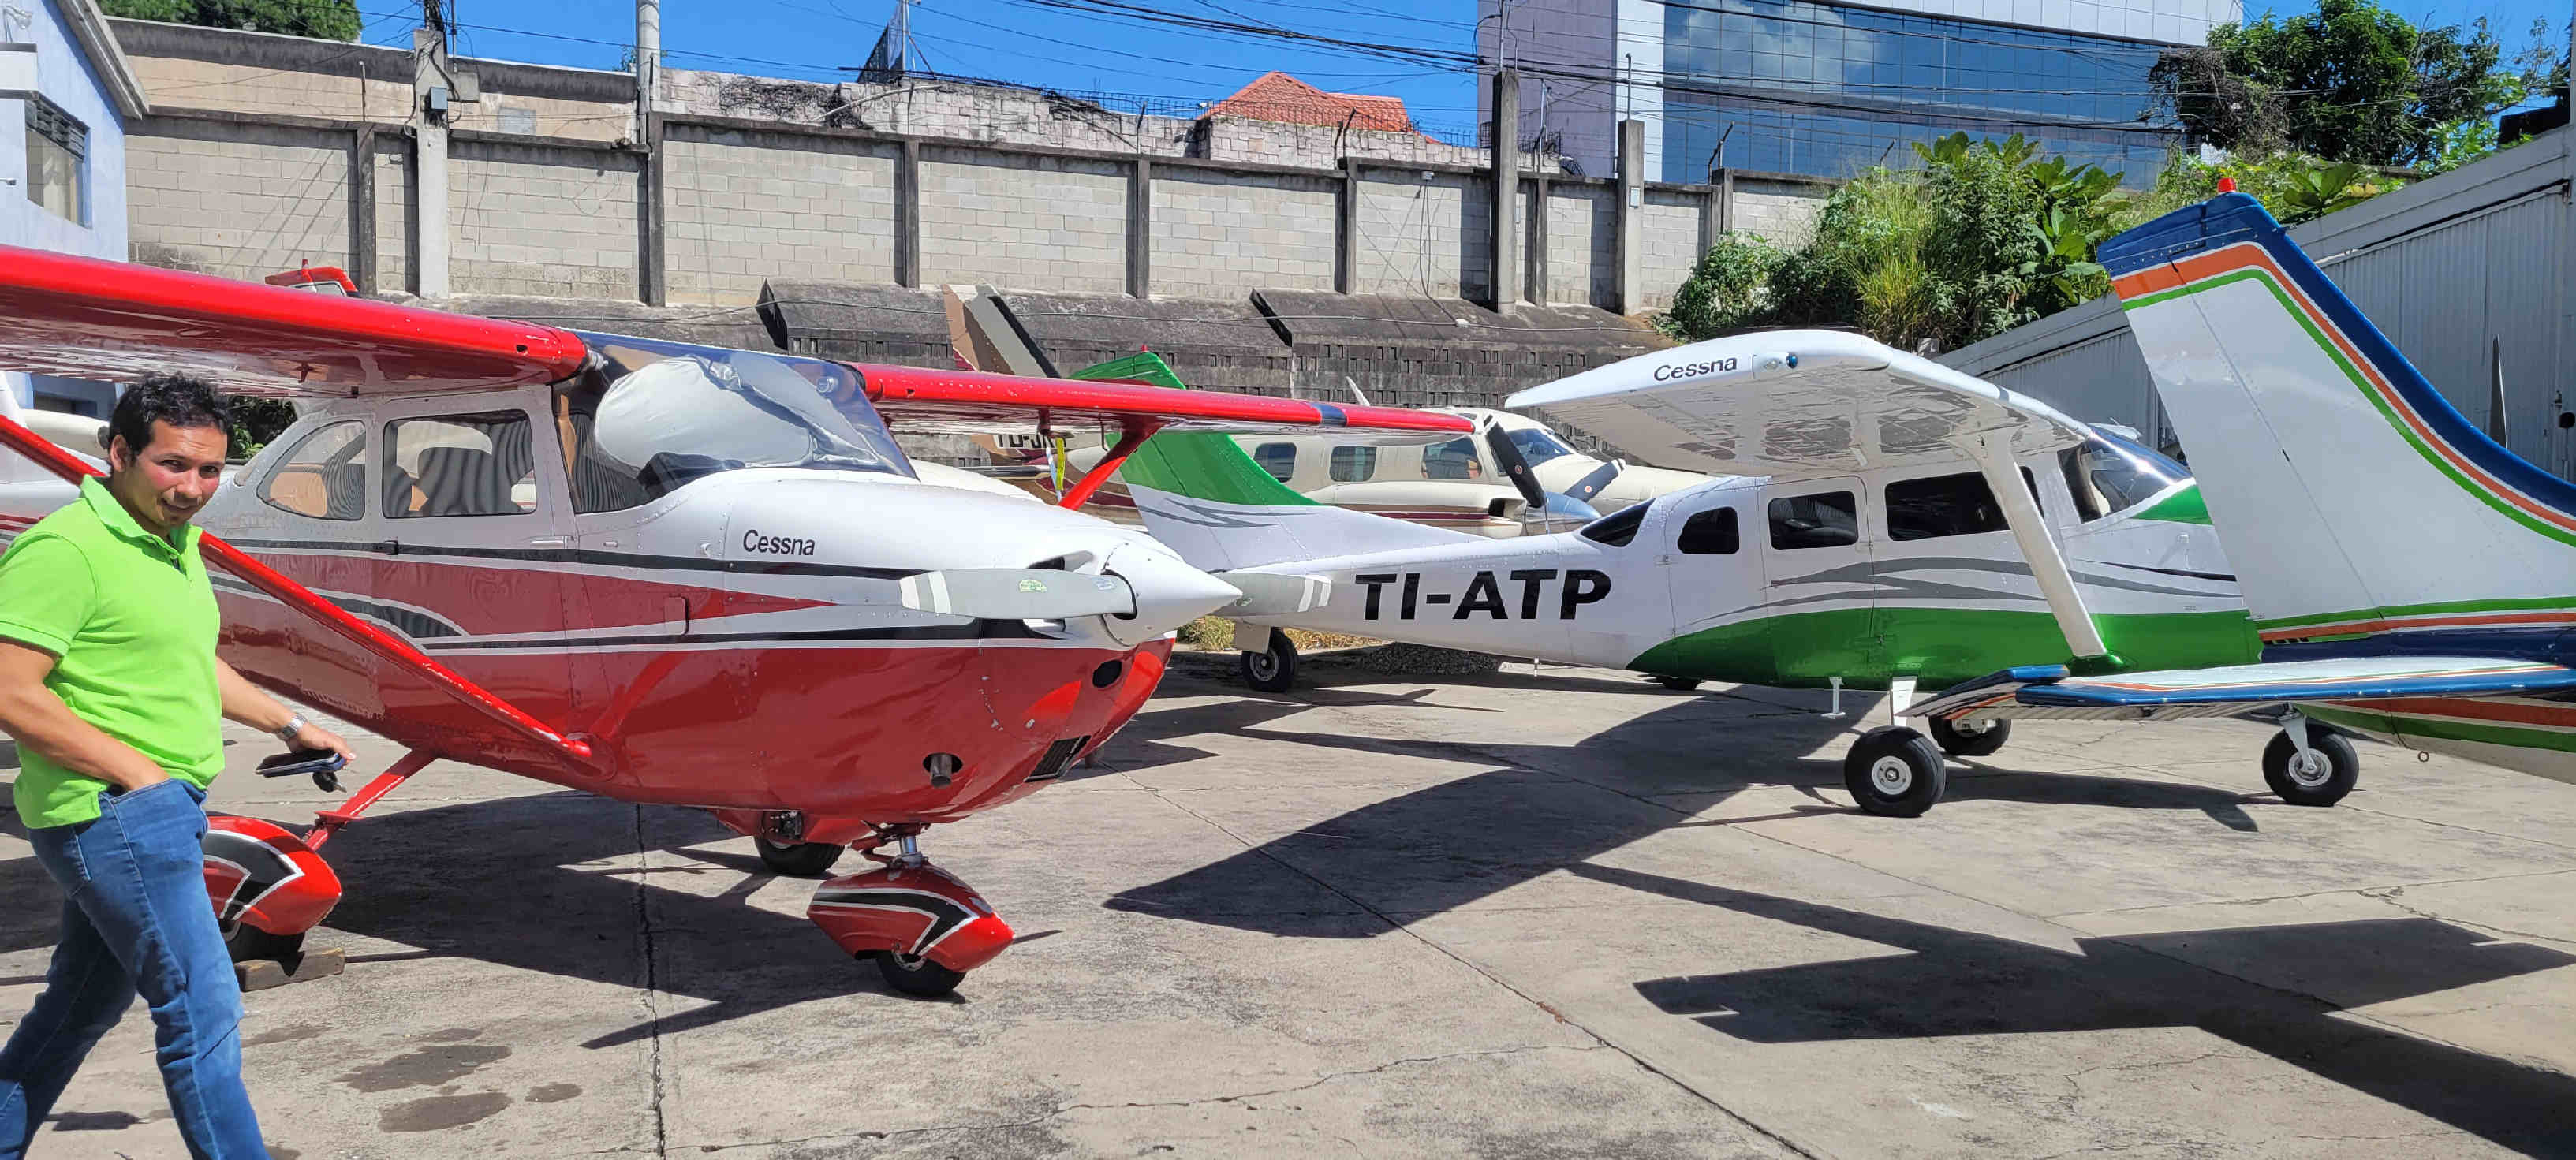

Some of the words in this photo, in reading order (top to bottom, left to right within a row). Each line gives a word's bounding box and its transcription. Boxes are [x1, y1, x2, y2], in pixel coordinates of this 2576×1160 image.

[1654, 357, 1738, 382] Cessna
[743, 529, 816, 556] Cessna
[1355, 569, 1612, 621] TI-ATP
